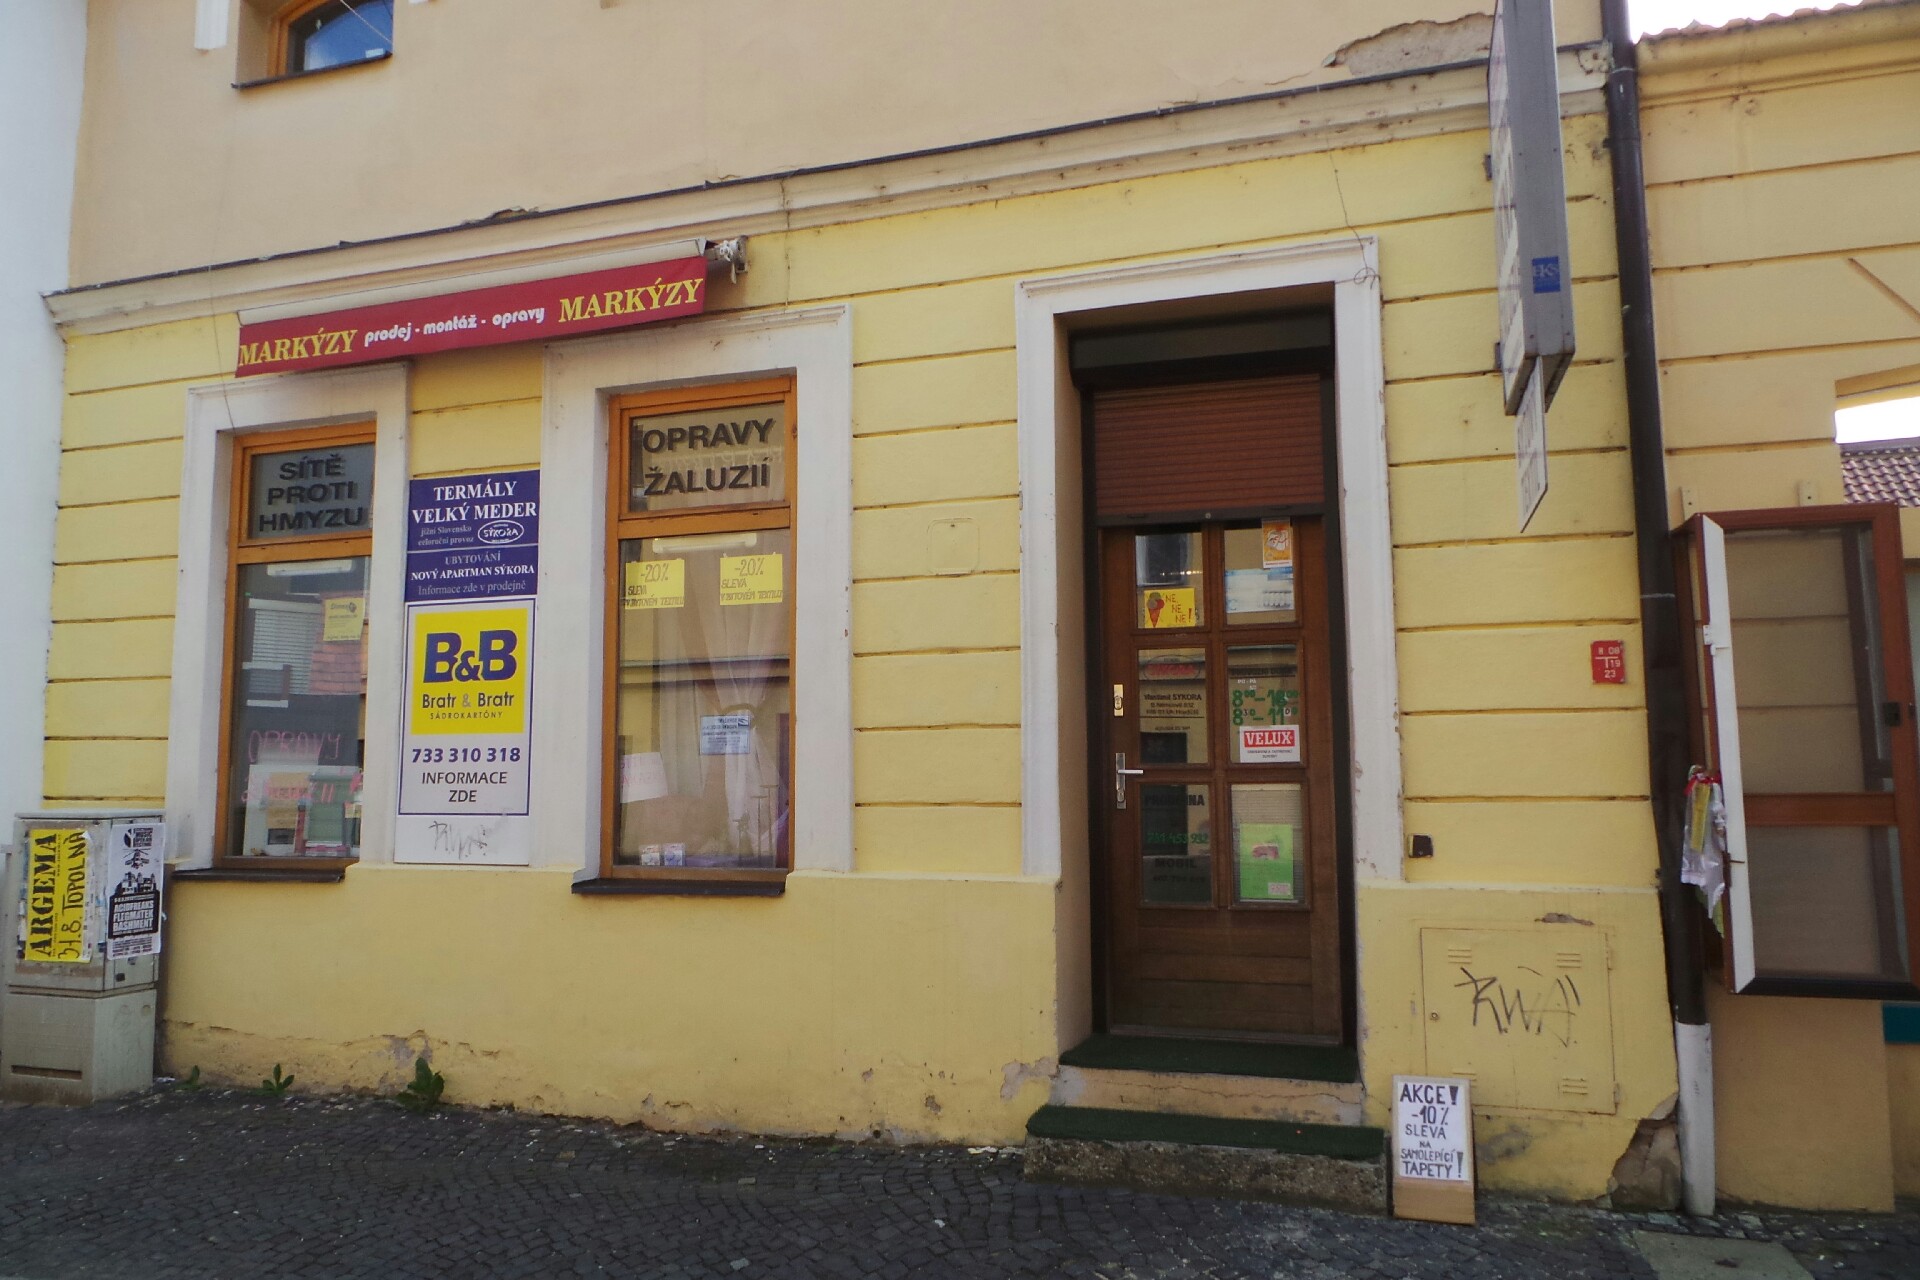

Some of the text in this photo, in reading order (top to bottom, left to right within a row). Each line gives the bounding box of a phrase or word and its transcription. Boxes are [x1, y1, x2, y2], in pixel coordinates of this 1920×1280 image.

[239, 328, 355, 366] MARKÝZY
[364, 322, 411, 347] prodej
[424, 314, 477, 336] montáž
[492, 306, 545, 330] opravy
[558, 277, 704, 322] MARKÝZY
[642, 418, 775, 453] OPRAVY
[280, 453, 344, 480] SÍTĚ
[644, 457, 772, 496] ŽALUZIÍ
[268, 481, 356, 505] PROTI
[433, 479, 517, 501] TERMÁLY
[260, 507, 365, 531] HMYZU
[411, 502, 537, 524] VELKÝ MEDER
[437, 525, 472, 535] Slovensko
[450, 536, 474, 545] provoz
[445, 551, 501, 565] UBYTOVÁNÍ
[411, 564, 535, 580] NOVÝ APARTMAN SÝKORA
[735, 558, 765, 577] -20%
[419, 584, 460, 595] Informace
[463, 583, 477, 592] zde
[487, 580, 526, 593] prodejně
[628, 585, 647, 596] SLEVA
[721, 578, 747, 589] SLEVA
[423, 629, 518, 683] B&B
[422, 692, 515, 709] Bratr & Bratr
[430, 710, 504, 720] SÁDROKARTÓNY
[1245, 731, 1291, 745] VELUX
[412, 747, 521, 763] 733 310 318
[421, 771, 508, 785] INFORMACE
[448, 790, 477, 803] ZDE
[29, 833, 57, 957] ARGEMA
[1400, 1083, 1459, 1105] AKCE!
[1412, 1105, 1449, 1126] -10%
[1405, 1124, 1446, 1139] SLEVA
[1419, 1140, 1431, 1149] NA
[1400, 1148, 1455, 1163] SAMOLEPÍCÍ
